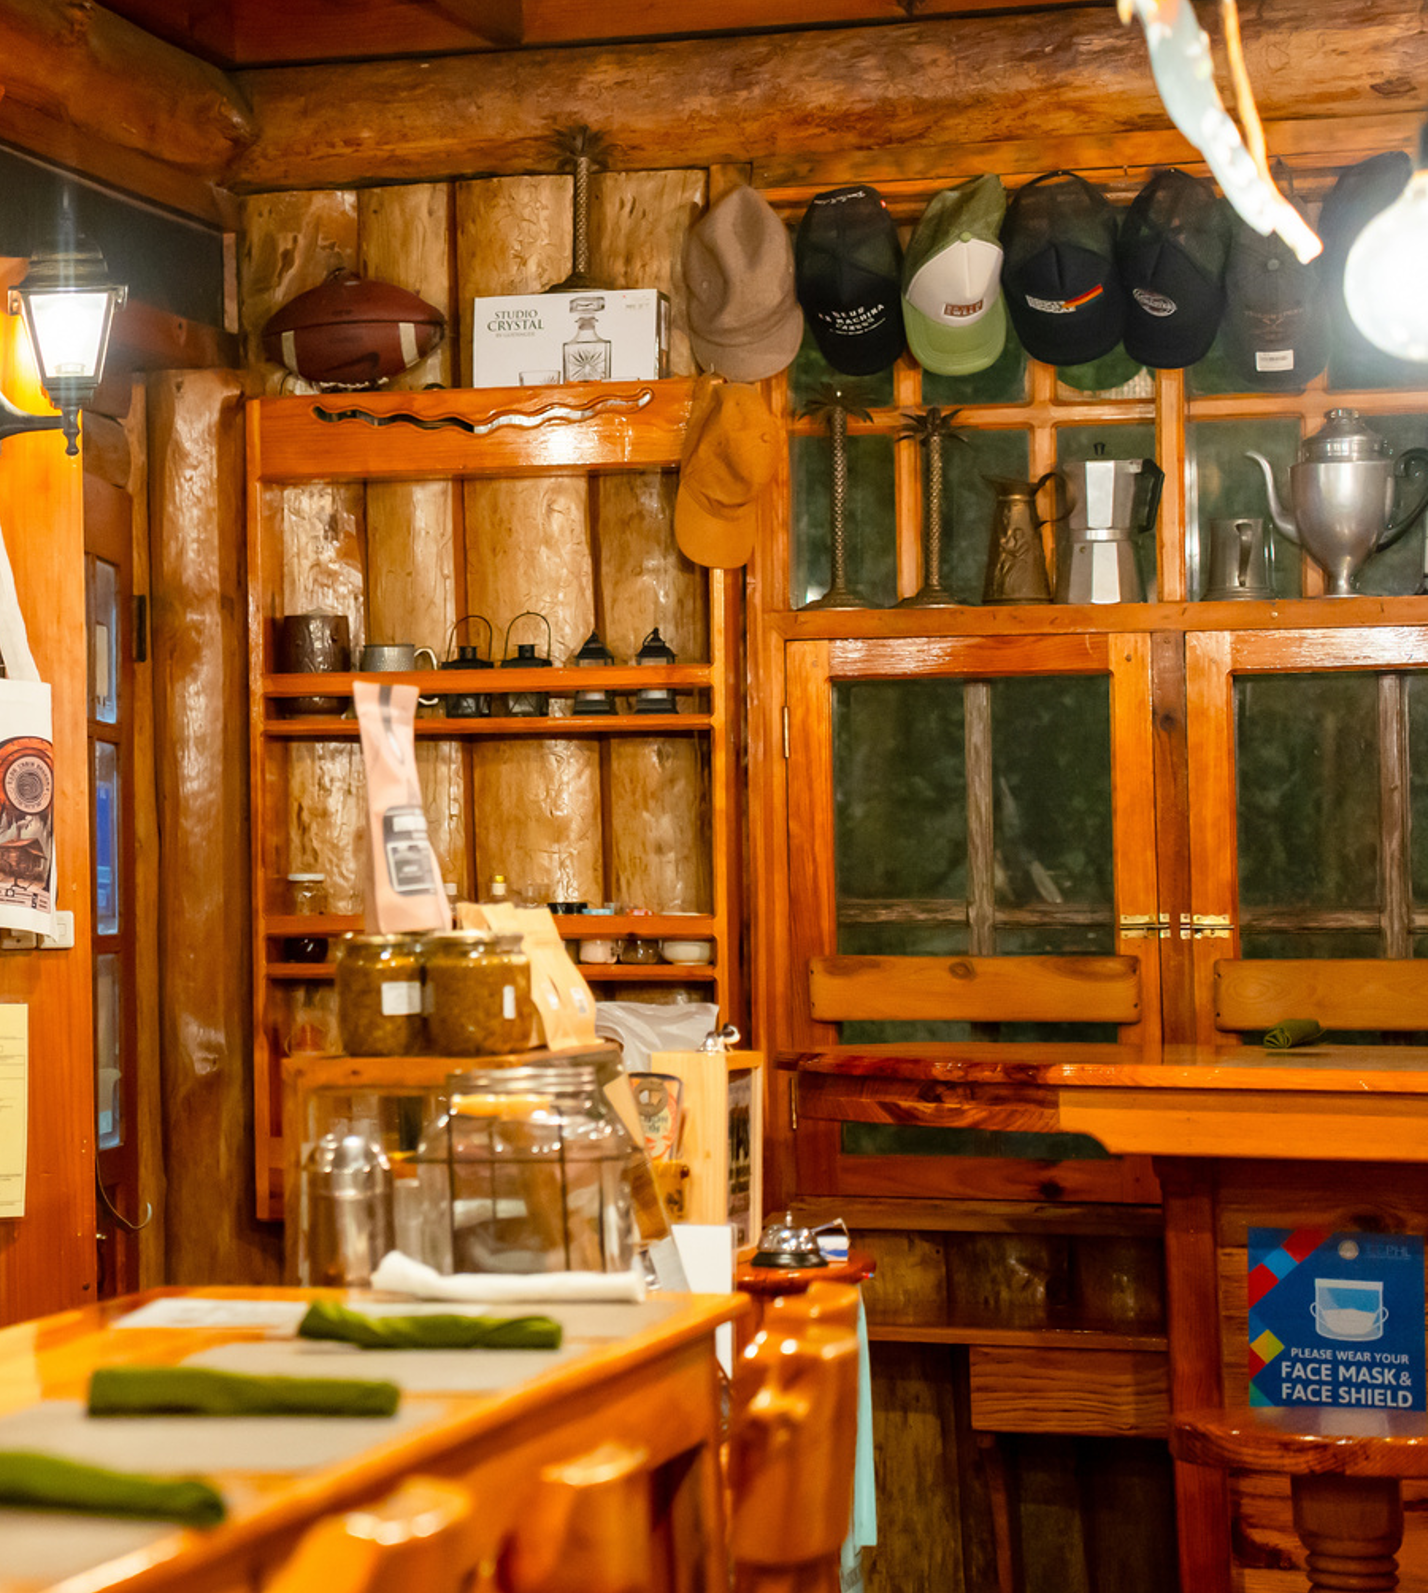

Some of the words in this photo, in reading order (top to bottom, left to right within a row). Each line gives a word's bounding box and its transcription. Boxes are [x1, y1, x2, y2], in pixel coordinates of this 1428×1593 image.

[494, 309, 538, 320] STUDIO
[487, 319, 544, 332] CRYSTAL
[1291, 1347, 1333, 1360] PLEASE
[1336, 1350, 1371, 1362] WEAR
[1374, 1352, 1410, 1364] YOUR
[1281, 1361, 1332, 1381] FACE
[1338, 1365, 1397, 1386] MASK
[1399, 1372, 1412, 1386] &
[1281, 1383, 1332, 1402] FACE
[1338, 1387, 1413, 1408] SHIELD
